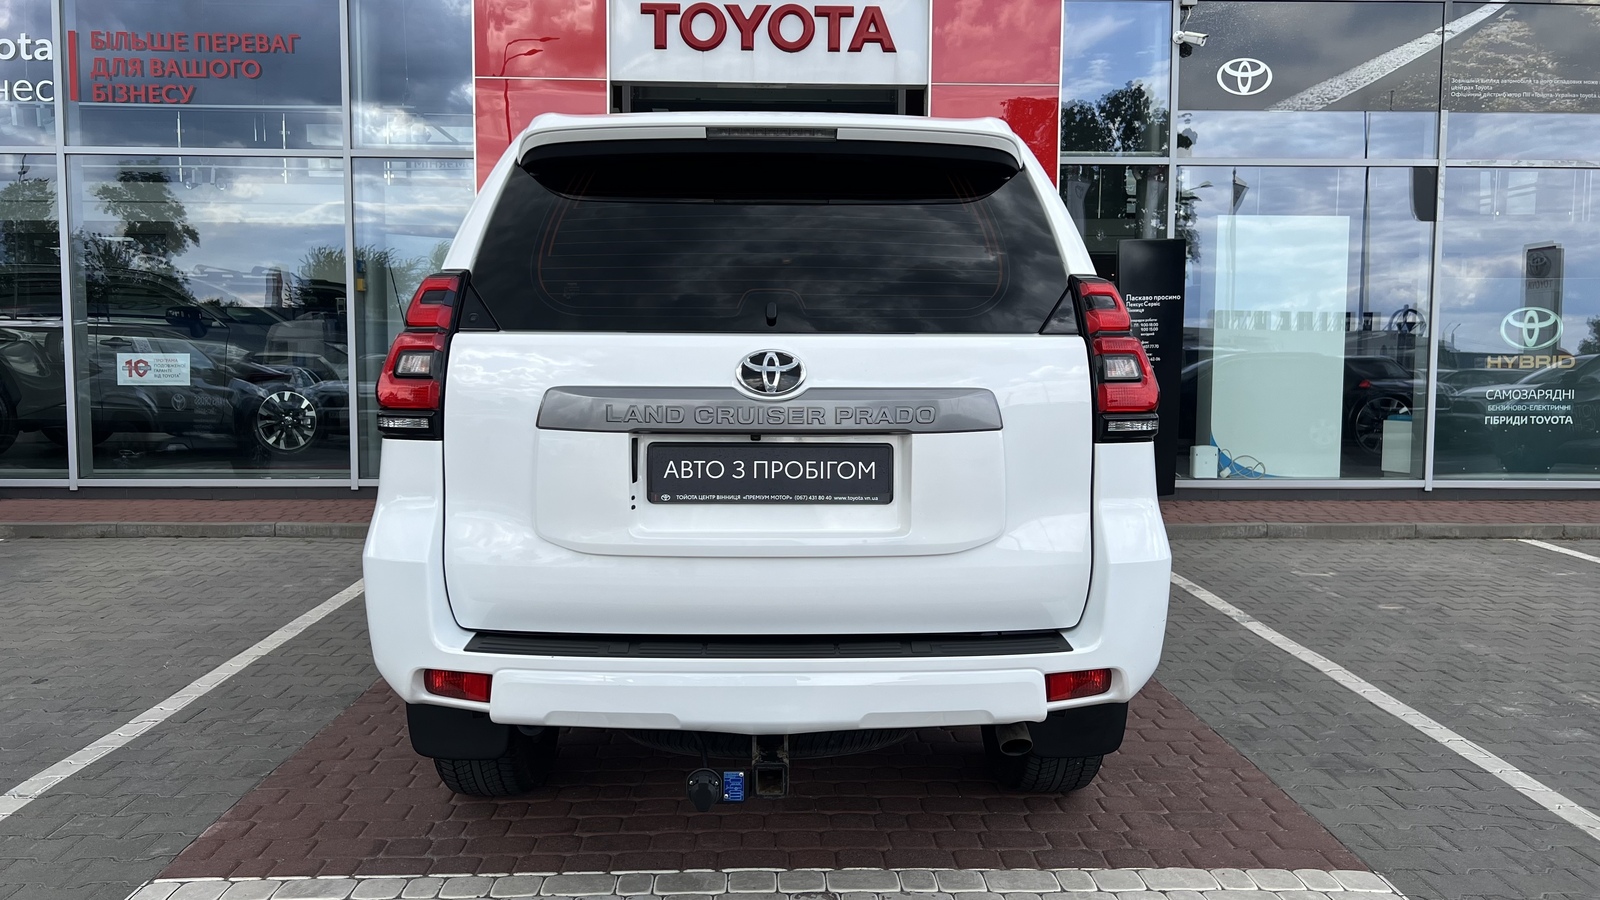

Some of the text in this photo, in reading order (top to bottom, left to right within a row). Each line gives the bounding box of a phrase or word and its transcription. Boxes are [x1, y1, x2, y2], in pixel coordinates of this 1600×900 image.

[640, 2, 897, 53] TOYOTA
[0, 33, 53, 60] ota
[90, 30, 300, 53] БІЛЬШЕ ПЕРЕВАГ
[90, 57, 261, 79] ДЛЯ ВАШОГО
[92, 83, 195, 104] БІЗНЕСУ
[1486, 355, 1576, 369] HYBRID
[1485, 390, 1575, 402] САМОЗАРЯДНІ
[605, 404, 936, 426] LAND CRUISER PRADO
[1484, 416, 1573, 426] ГІБРИДИ TOYOTA
[663, 460, 725, 480] АВТО
[753, 460, 877, 480] ПРОБІГОМ
